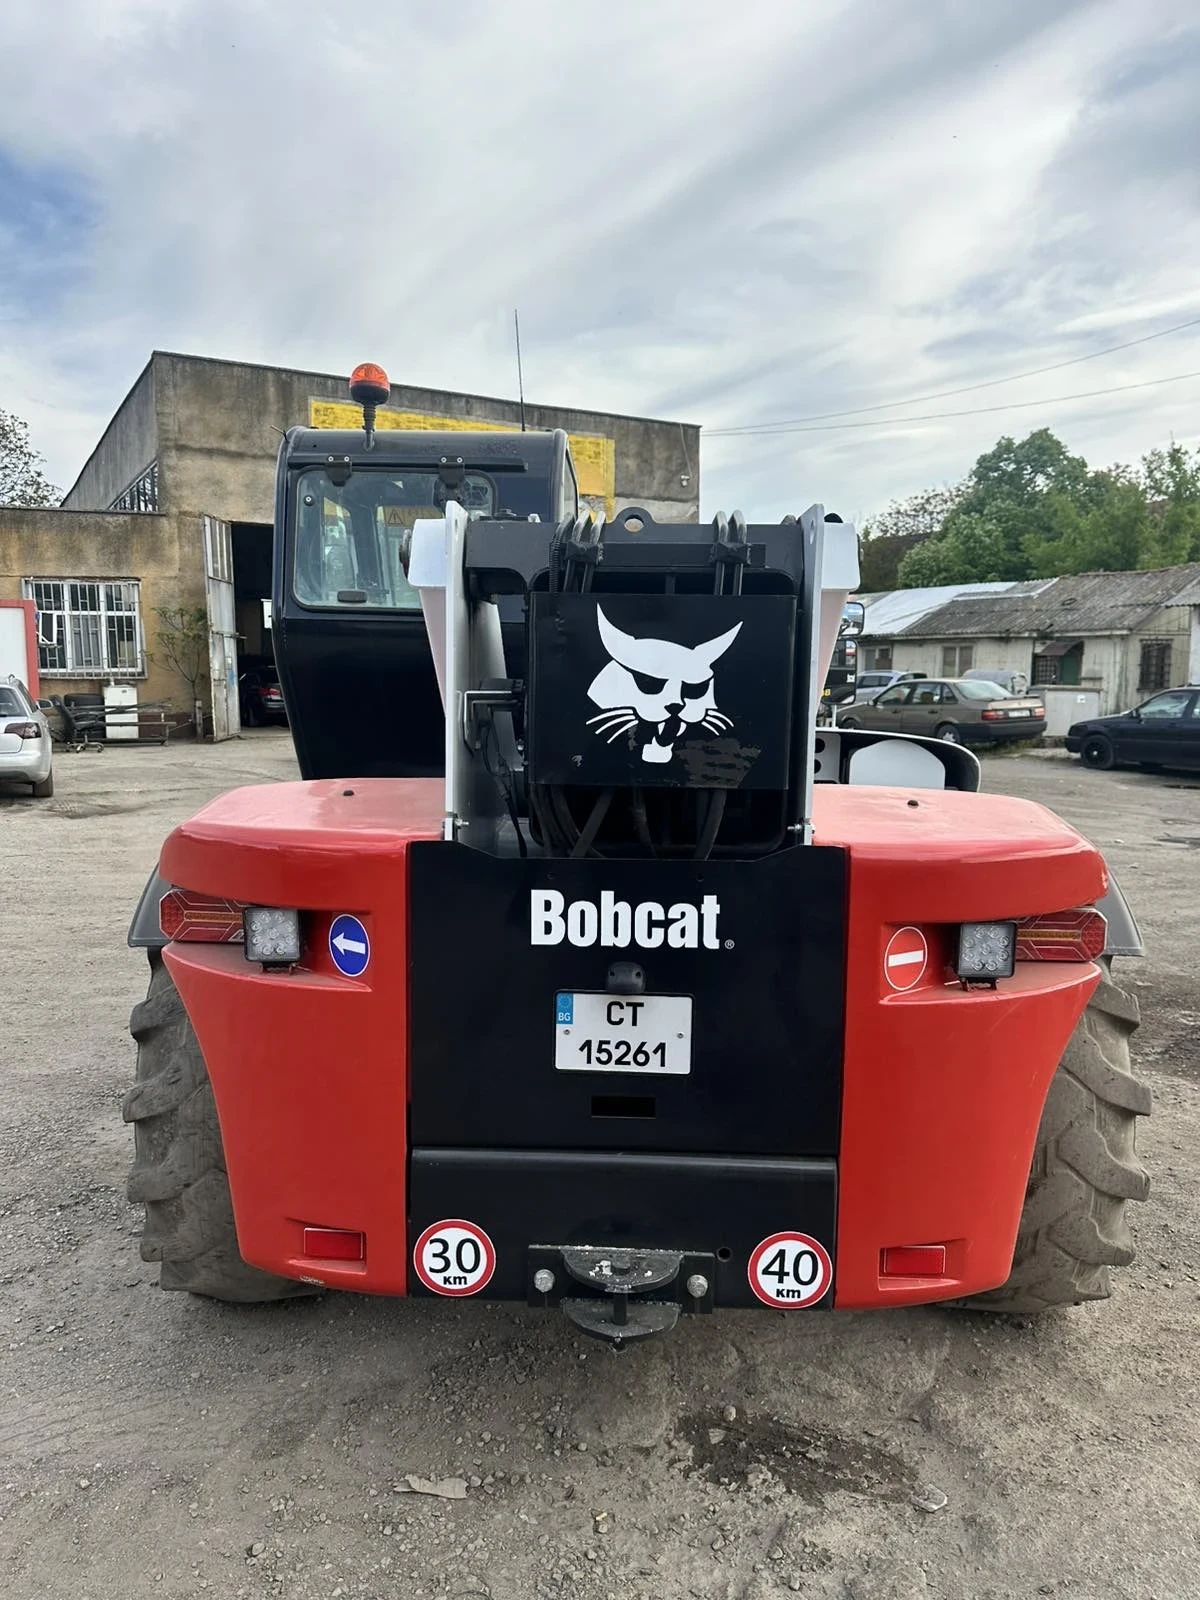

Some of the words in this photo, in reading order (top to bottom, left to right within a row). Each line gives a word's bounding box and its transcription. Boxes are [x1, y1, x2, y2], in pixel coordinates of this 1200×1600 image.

[531, 889, 721, 950] Bobcat
[558, 1012, 571, 1022] BG
[606, 1000, 645, 1027] CT
[578, 1039, 667, 1067] 15261
[428, 1237, 481, 1274] 30
[761, 1248, 819, 1286] 40
